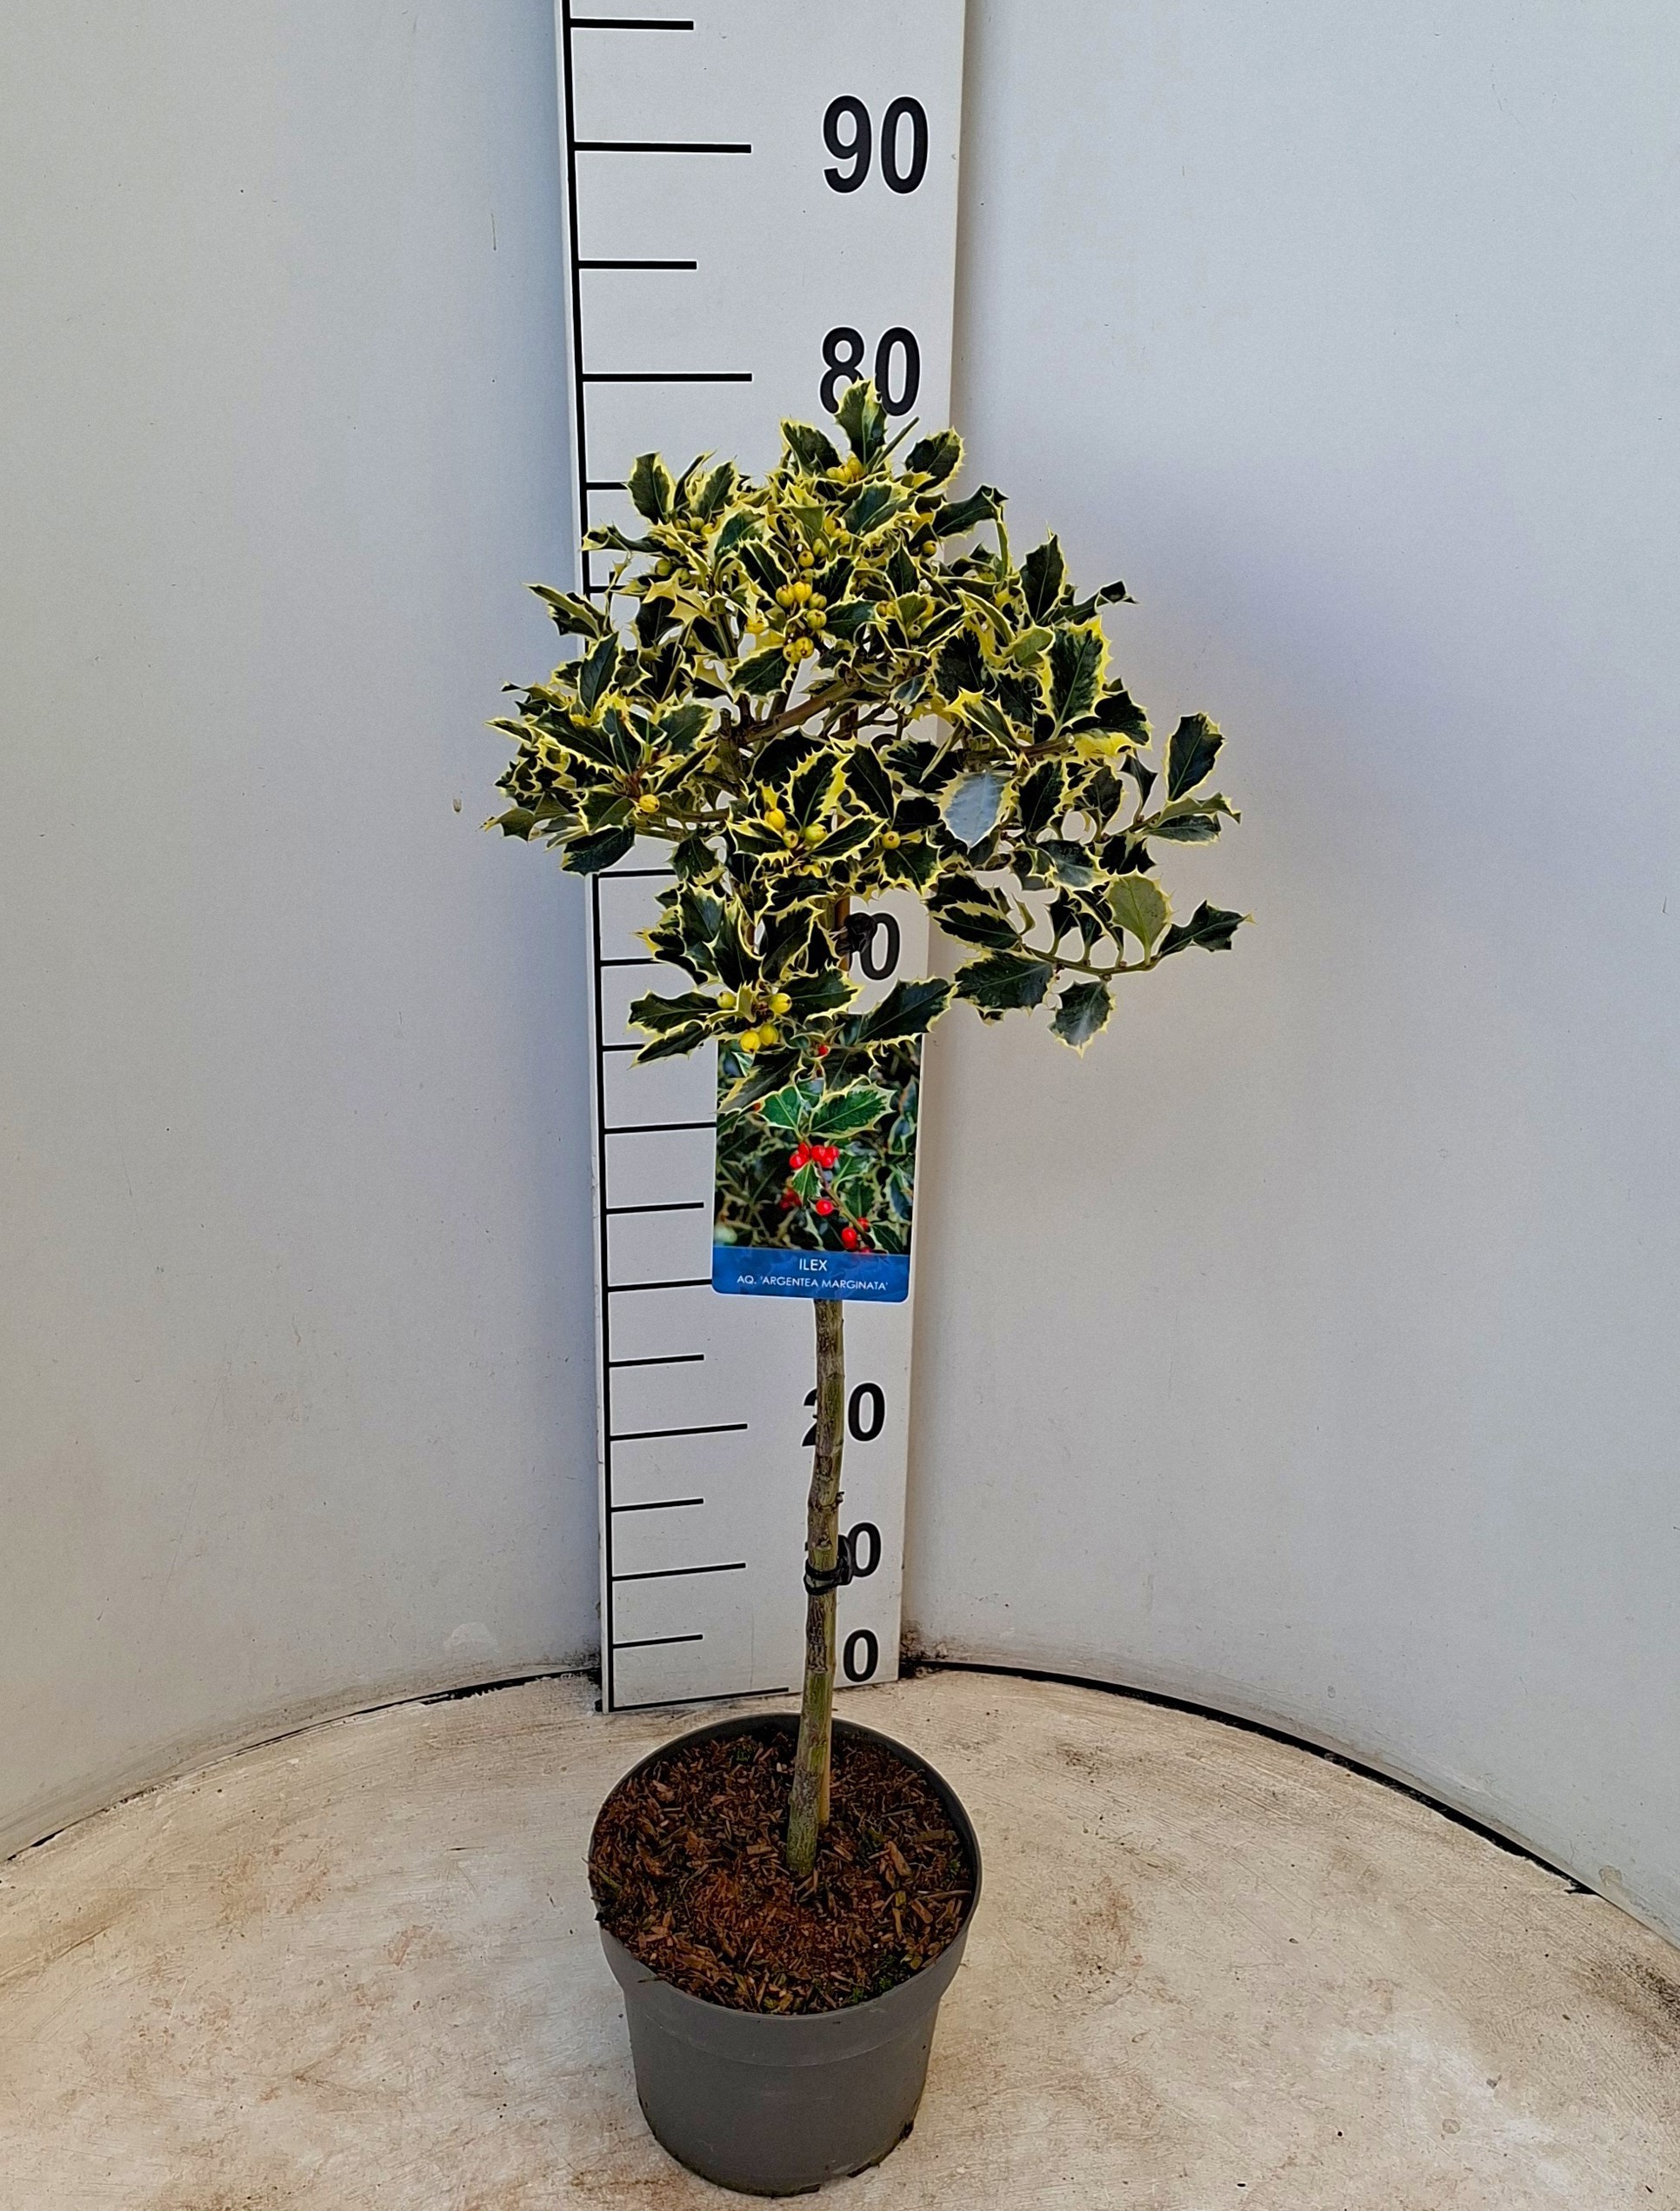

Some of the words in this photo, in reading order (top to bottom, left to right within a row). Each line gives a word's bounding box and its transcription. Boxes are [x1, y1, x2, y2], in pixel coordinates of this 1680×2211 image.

[823, 96, 929, 194] 90
[820, 327, 920, 416] 80
[737, 1275, 757, 1285] AQ.
[760, 1275, 818, 1288] 'ARGENTEA
[822, 1280, 888, 1291] MARGINATA'
[798, 1258, 828, 1272] ILEX
[843, 1629, 878, 1682] 0
